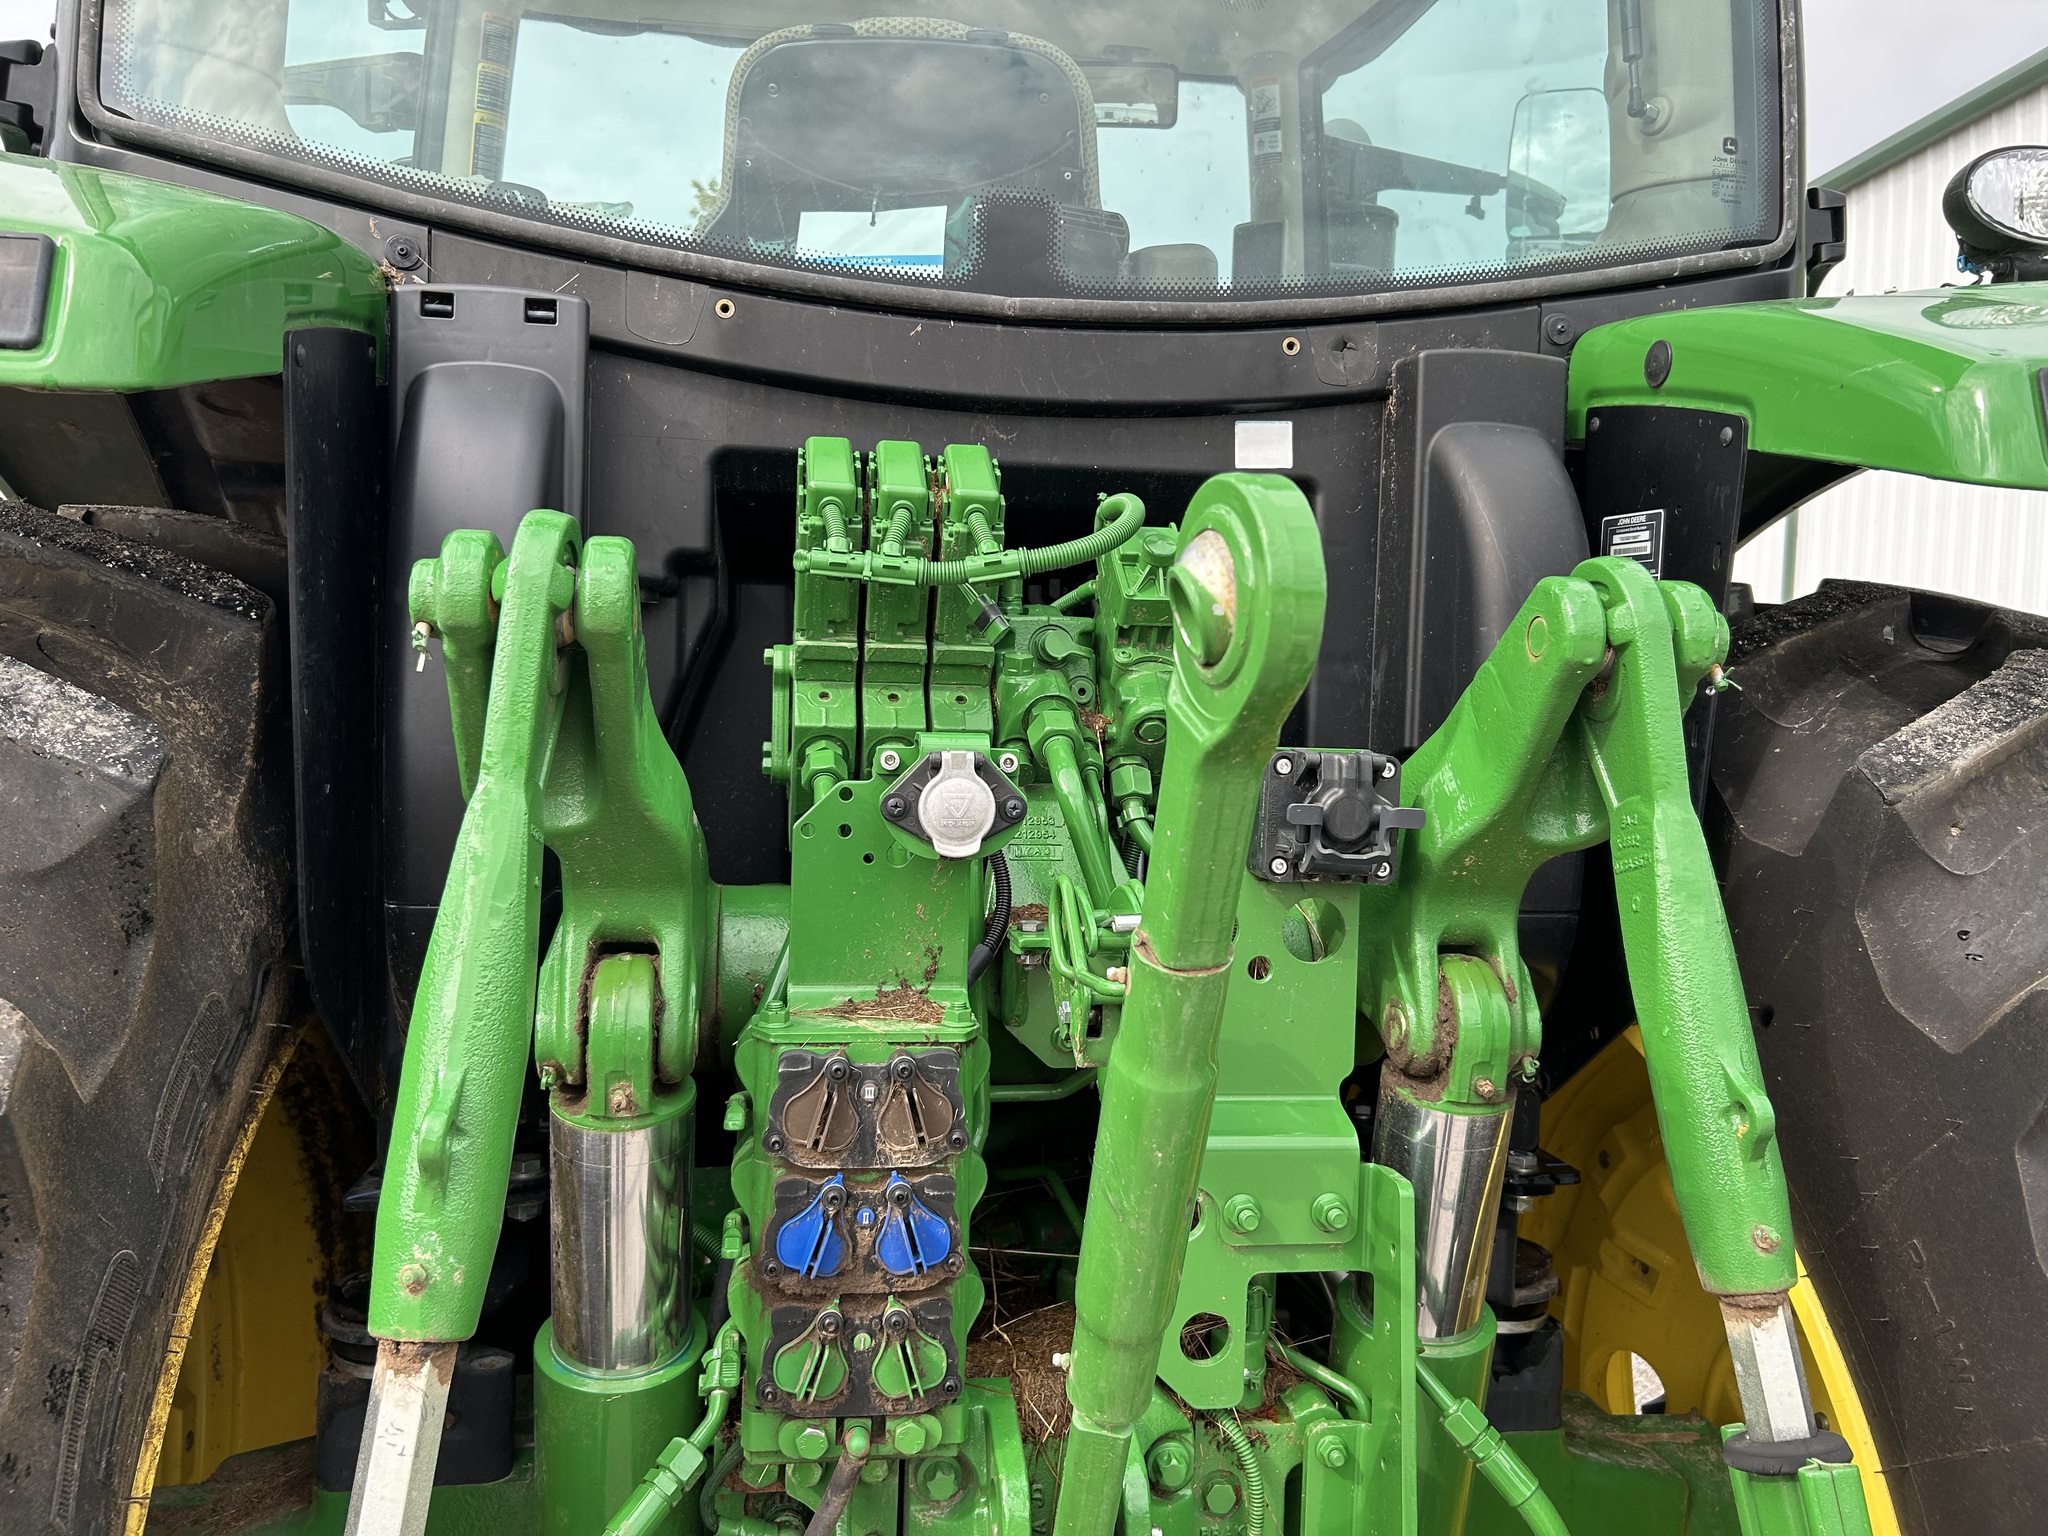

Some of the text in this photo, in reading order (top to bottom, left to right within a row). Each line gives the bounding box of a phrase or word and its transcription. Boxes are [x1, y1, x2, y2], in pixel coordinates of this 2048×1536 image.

[1617, 515, 1647, 526] JOHN DEERE
[862, 1212, 869, 1224] II
